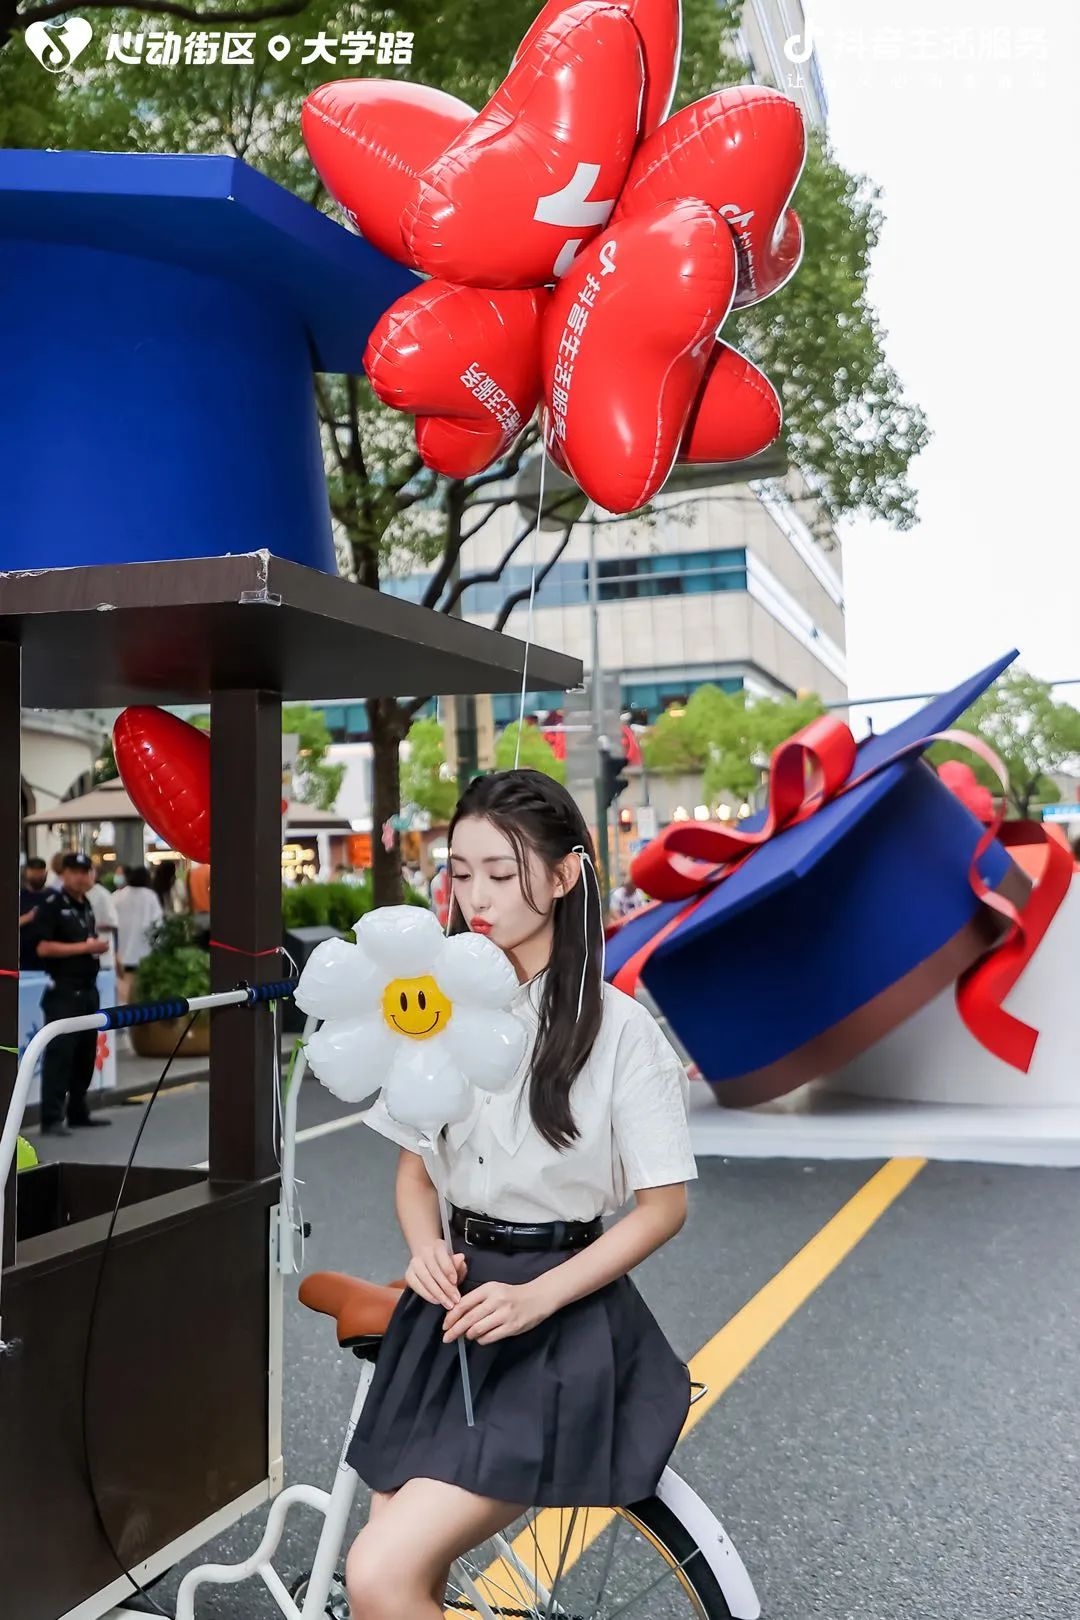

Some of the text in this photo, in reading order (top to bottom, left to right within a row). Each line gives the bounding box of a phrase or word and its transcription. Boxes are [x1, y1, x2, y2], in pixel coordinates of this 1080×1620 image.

[460, 361, 522, 440] 音生活服务
[552, 273, 600, 441] 抖音生活服务
